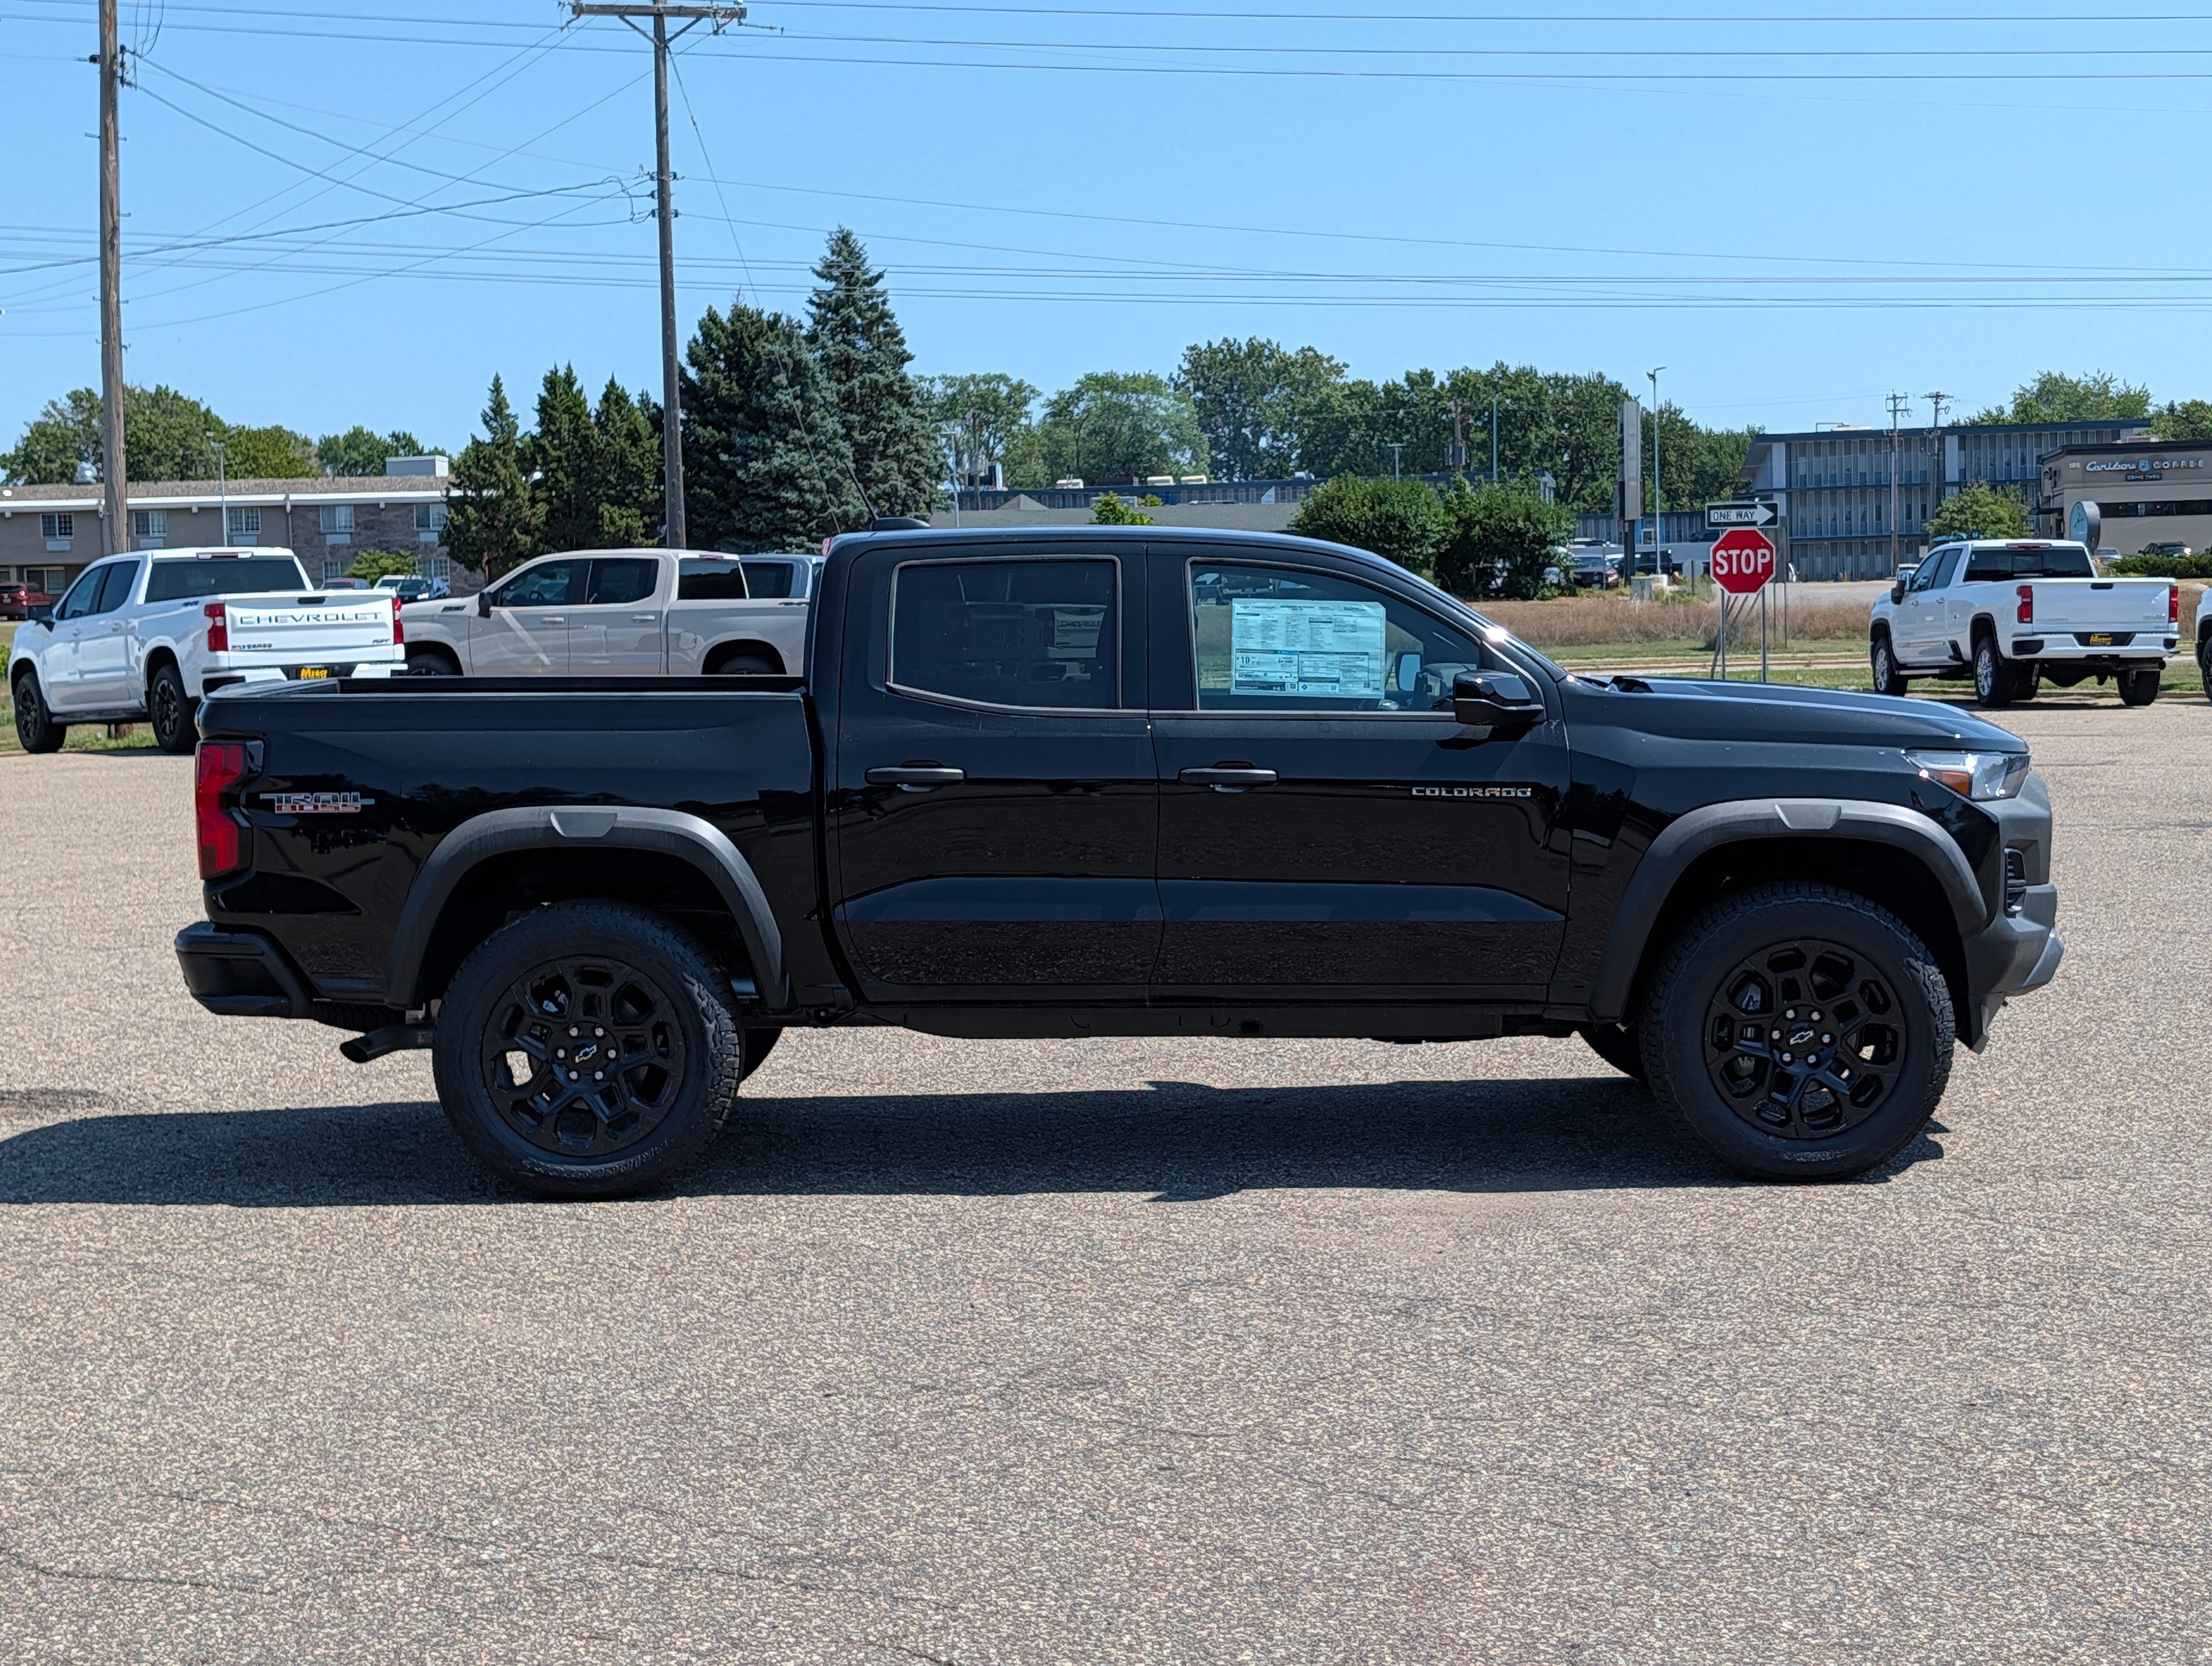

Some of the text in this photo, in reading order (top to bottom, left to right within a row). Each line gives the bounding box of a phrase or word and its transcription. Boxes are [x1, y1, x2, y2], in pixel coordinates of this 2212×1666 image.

[2086, 461, 2136, 471] Caribou
[1713, 511, 1754, 521] ONE WAY
[1715, 548, 1770, 575] STOP
[240, 612, 382, 625] CHEVROLET
[1412, 787, 1532, 797] COLORADO
